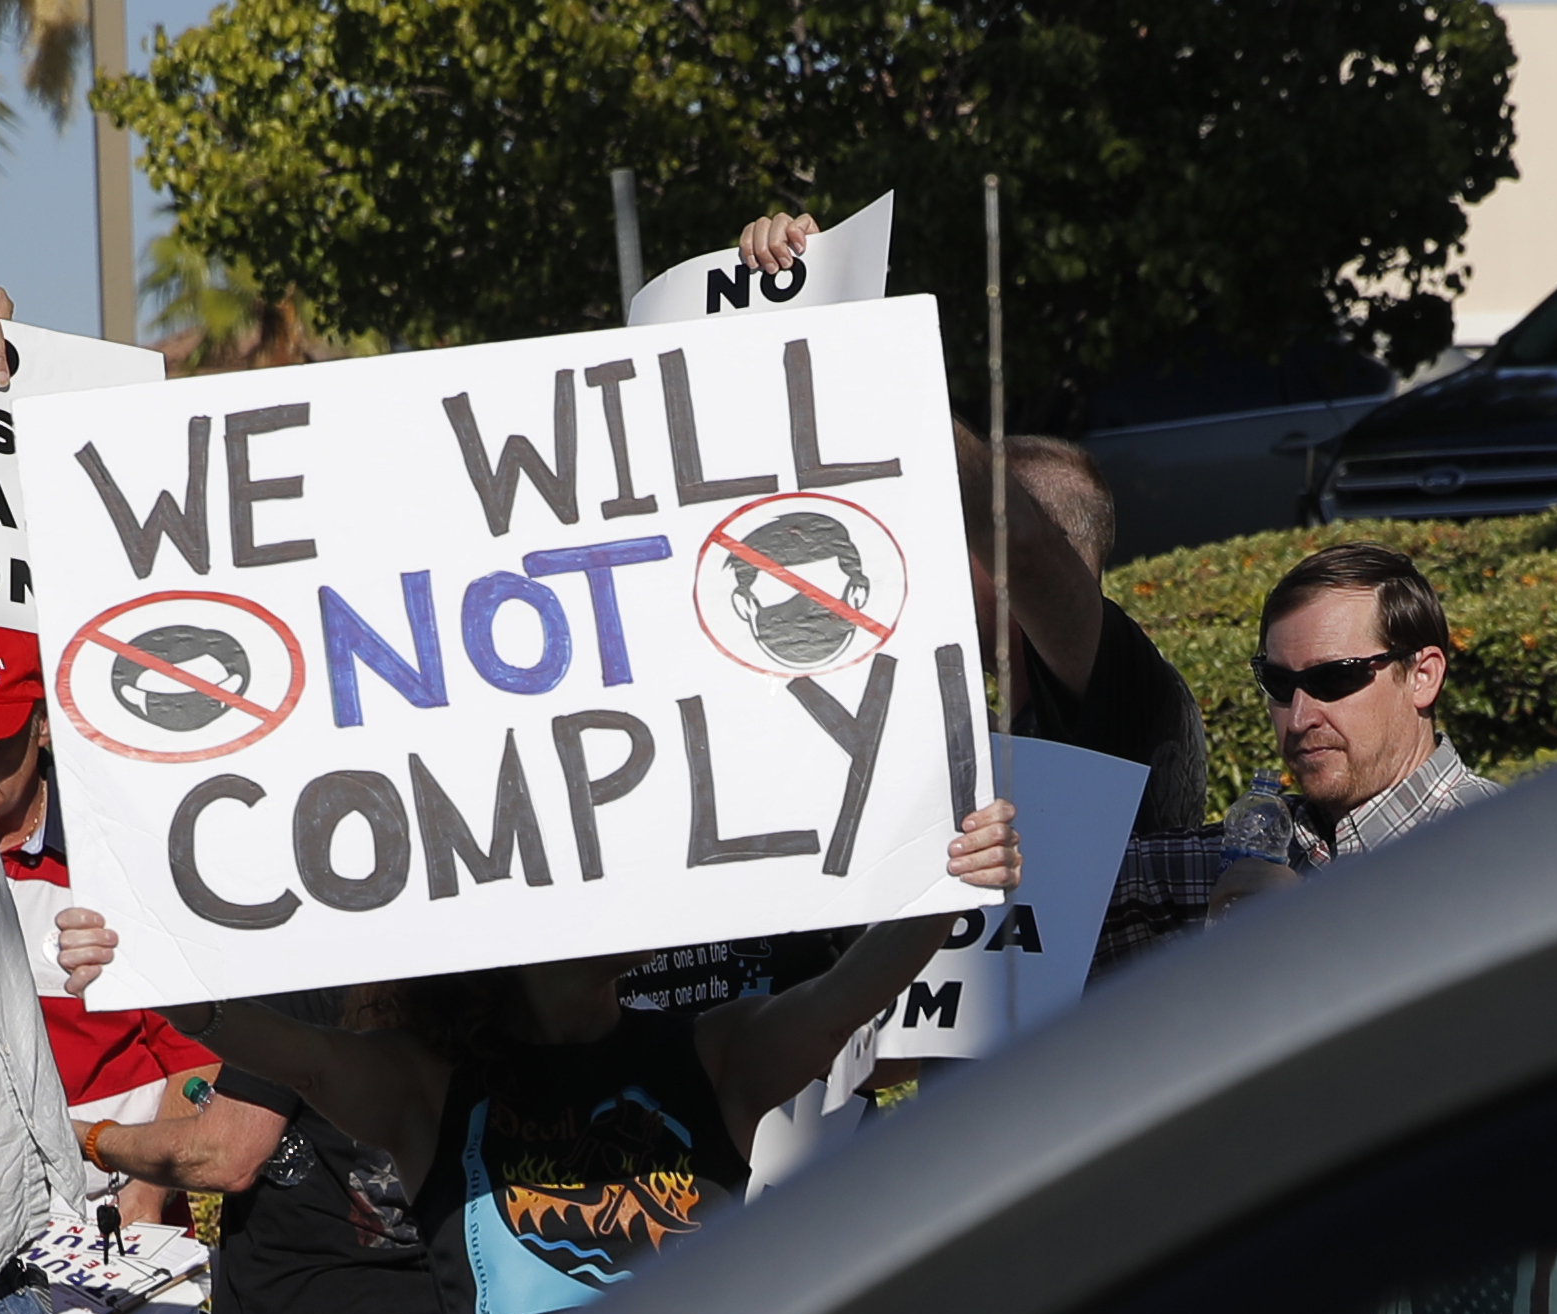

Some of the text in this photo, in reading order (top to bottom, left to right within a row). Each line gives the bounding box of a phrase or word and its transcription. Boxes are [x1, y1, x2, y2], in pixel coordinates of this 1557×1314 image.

[706, 256, 807, 314] NO
[74, 338, 903, 580] WE WILL
[318, 535, 672, 728] NOT
[673, 949, 694, 969] one
[710, 942, 729, 962] the
[674, 988, 693, 1006] one
[695, 983, 707, 1001] on
[710, 975, 729, 999] the
